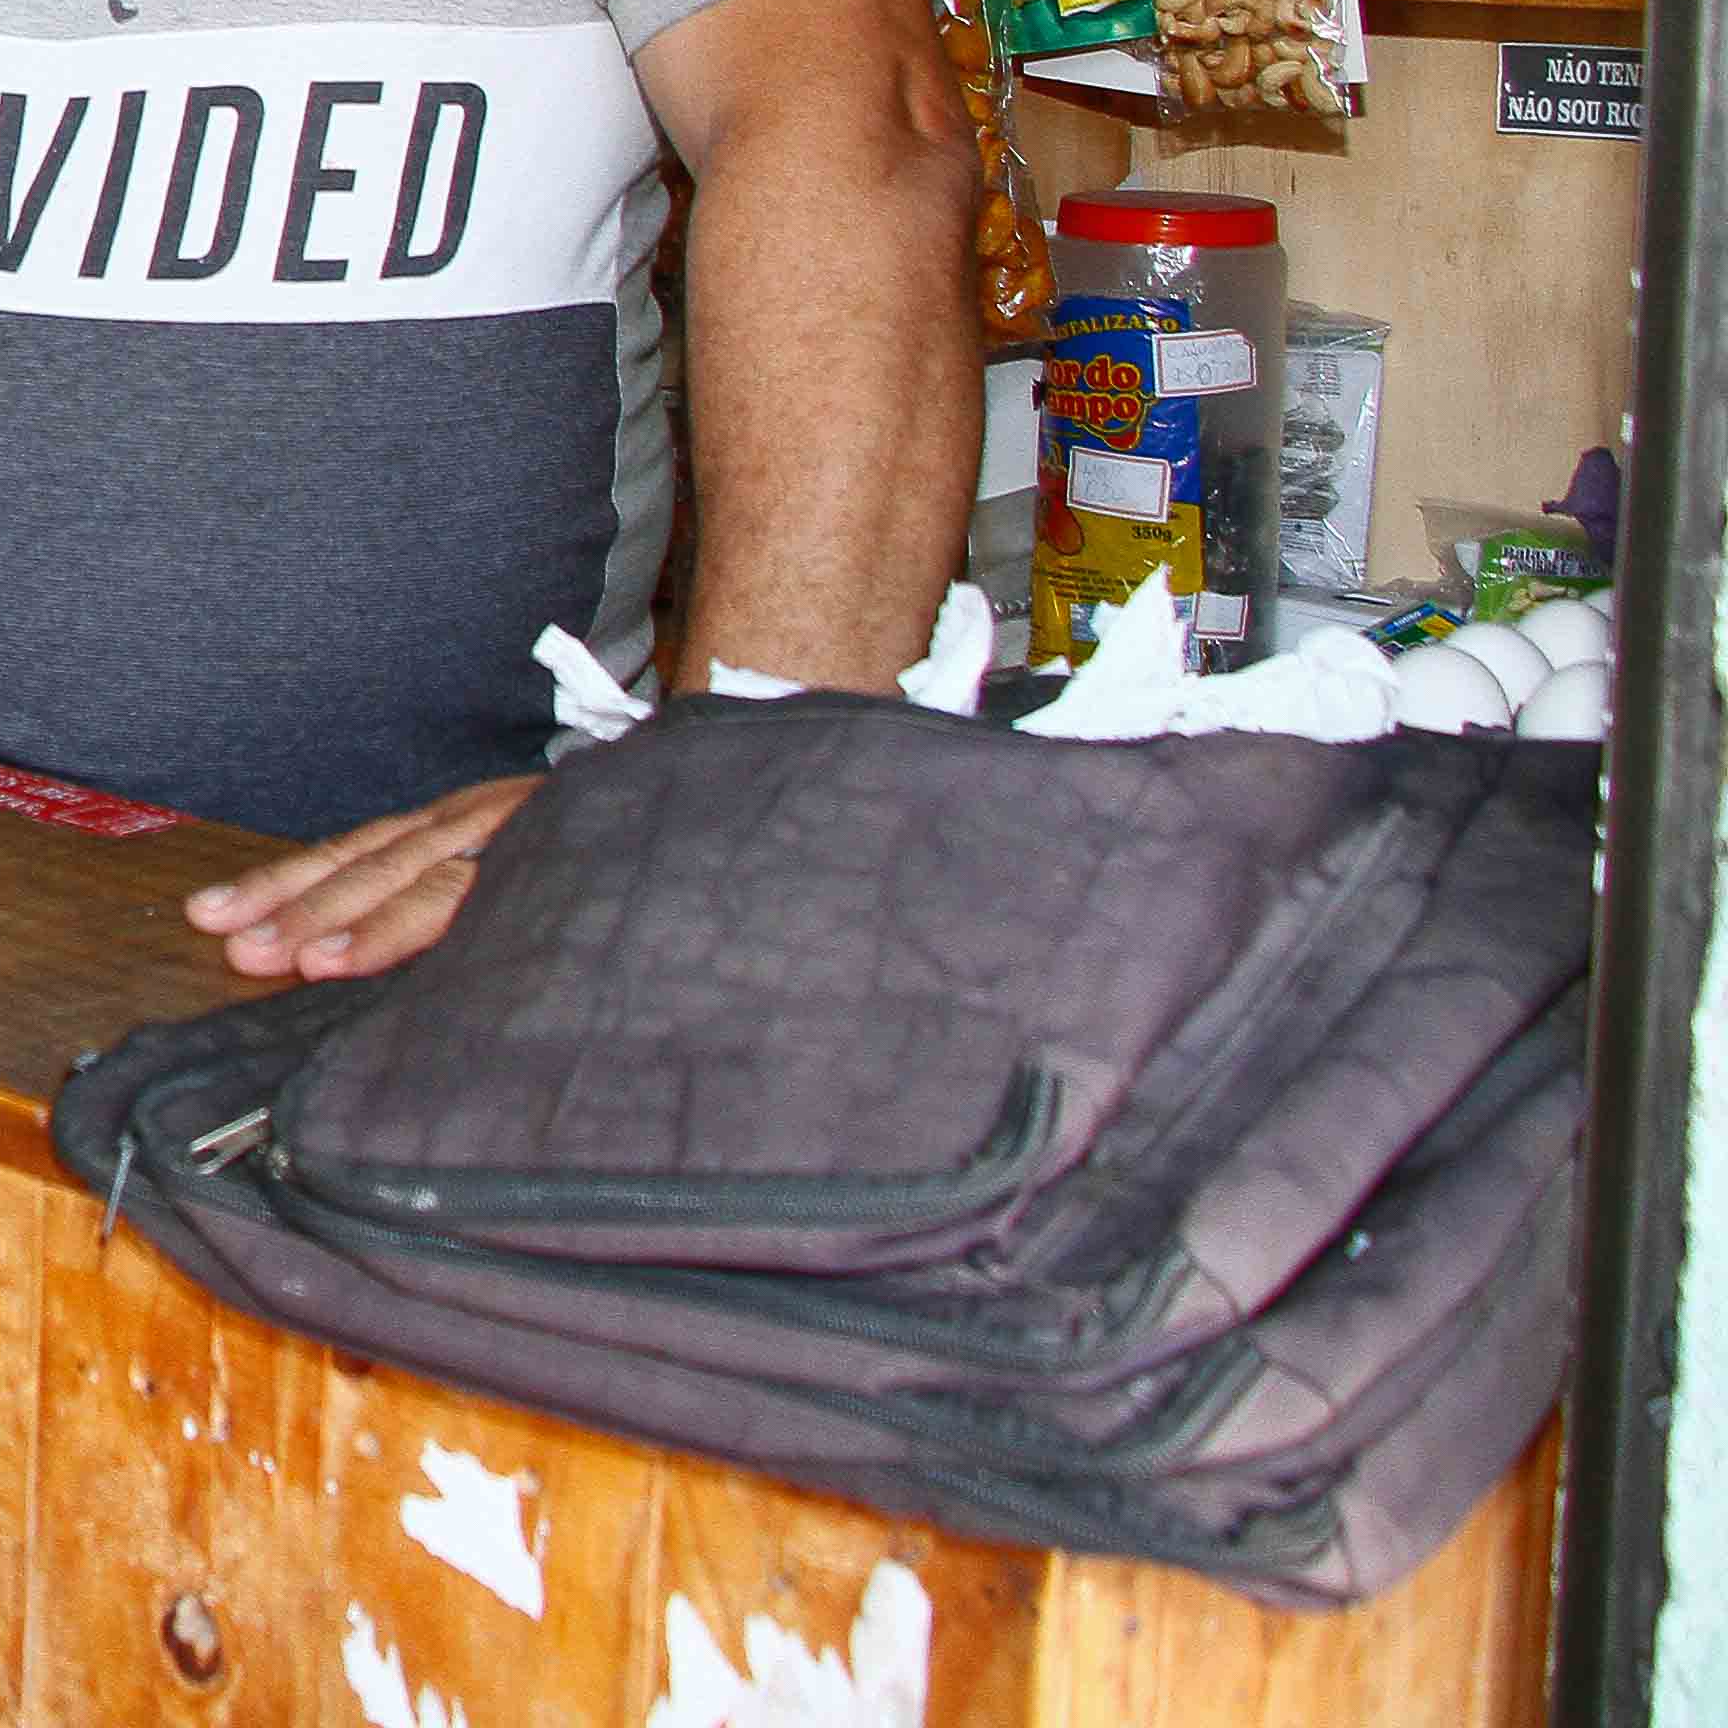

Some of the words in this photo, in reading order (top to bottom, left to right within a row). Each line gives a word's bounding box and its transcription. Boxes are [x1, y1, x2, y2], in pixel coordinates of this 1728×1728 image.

[1546, 53, 1592, 87] NÃO
[1507, 90, 1553, 122] NÃO
[1556, 97, 1600, 126] SOU
[1605, 98, 1645, 128] RIC
[1085, 354, 1141, 390] do
